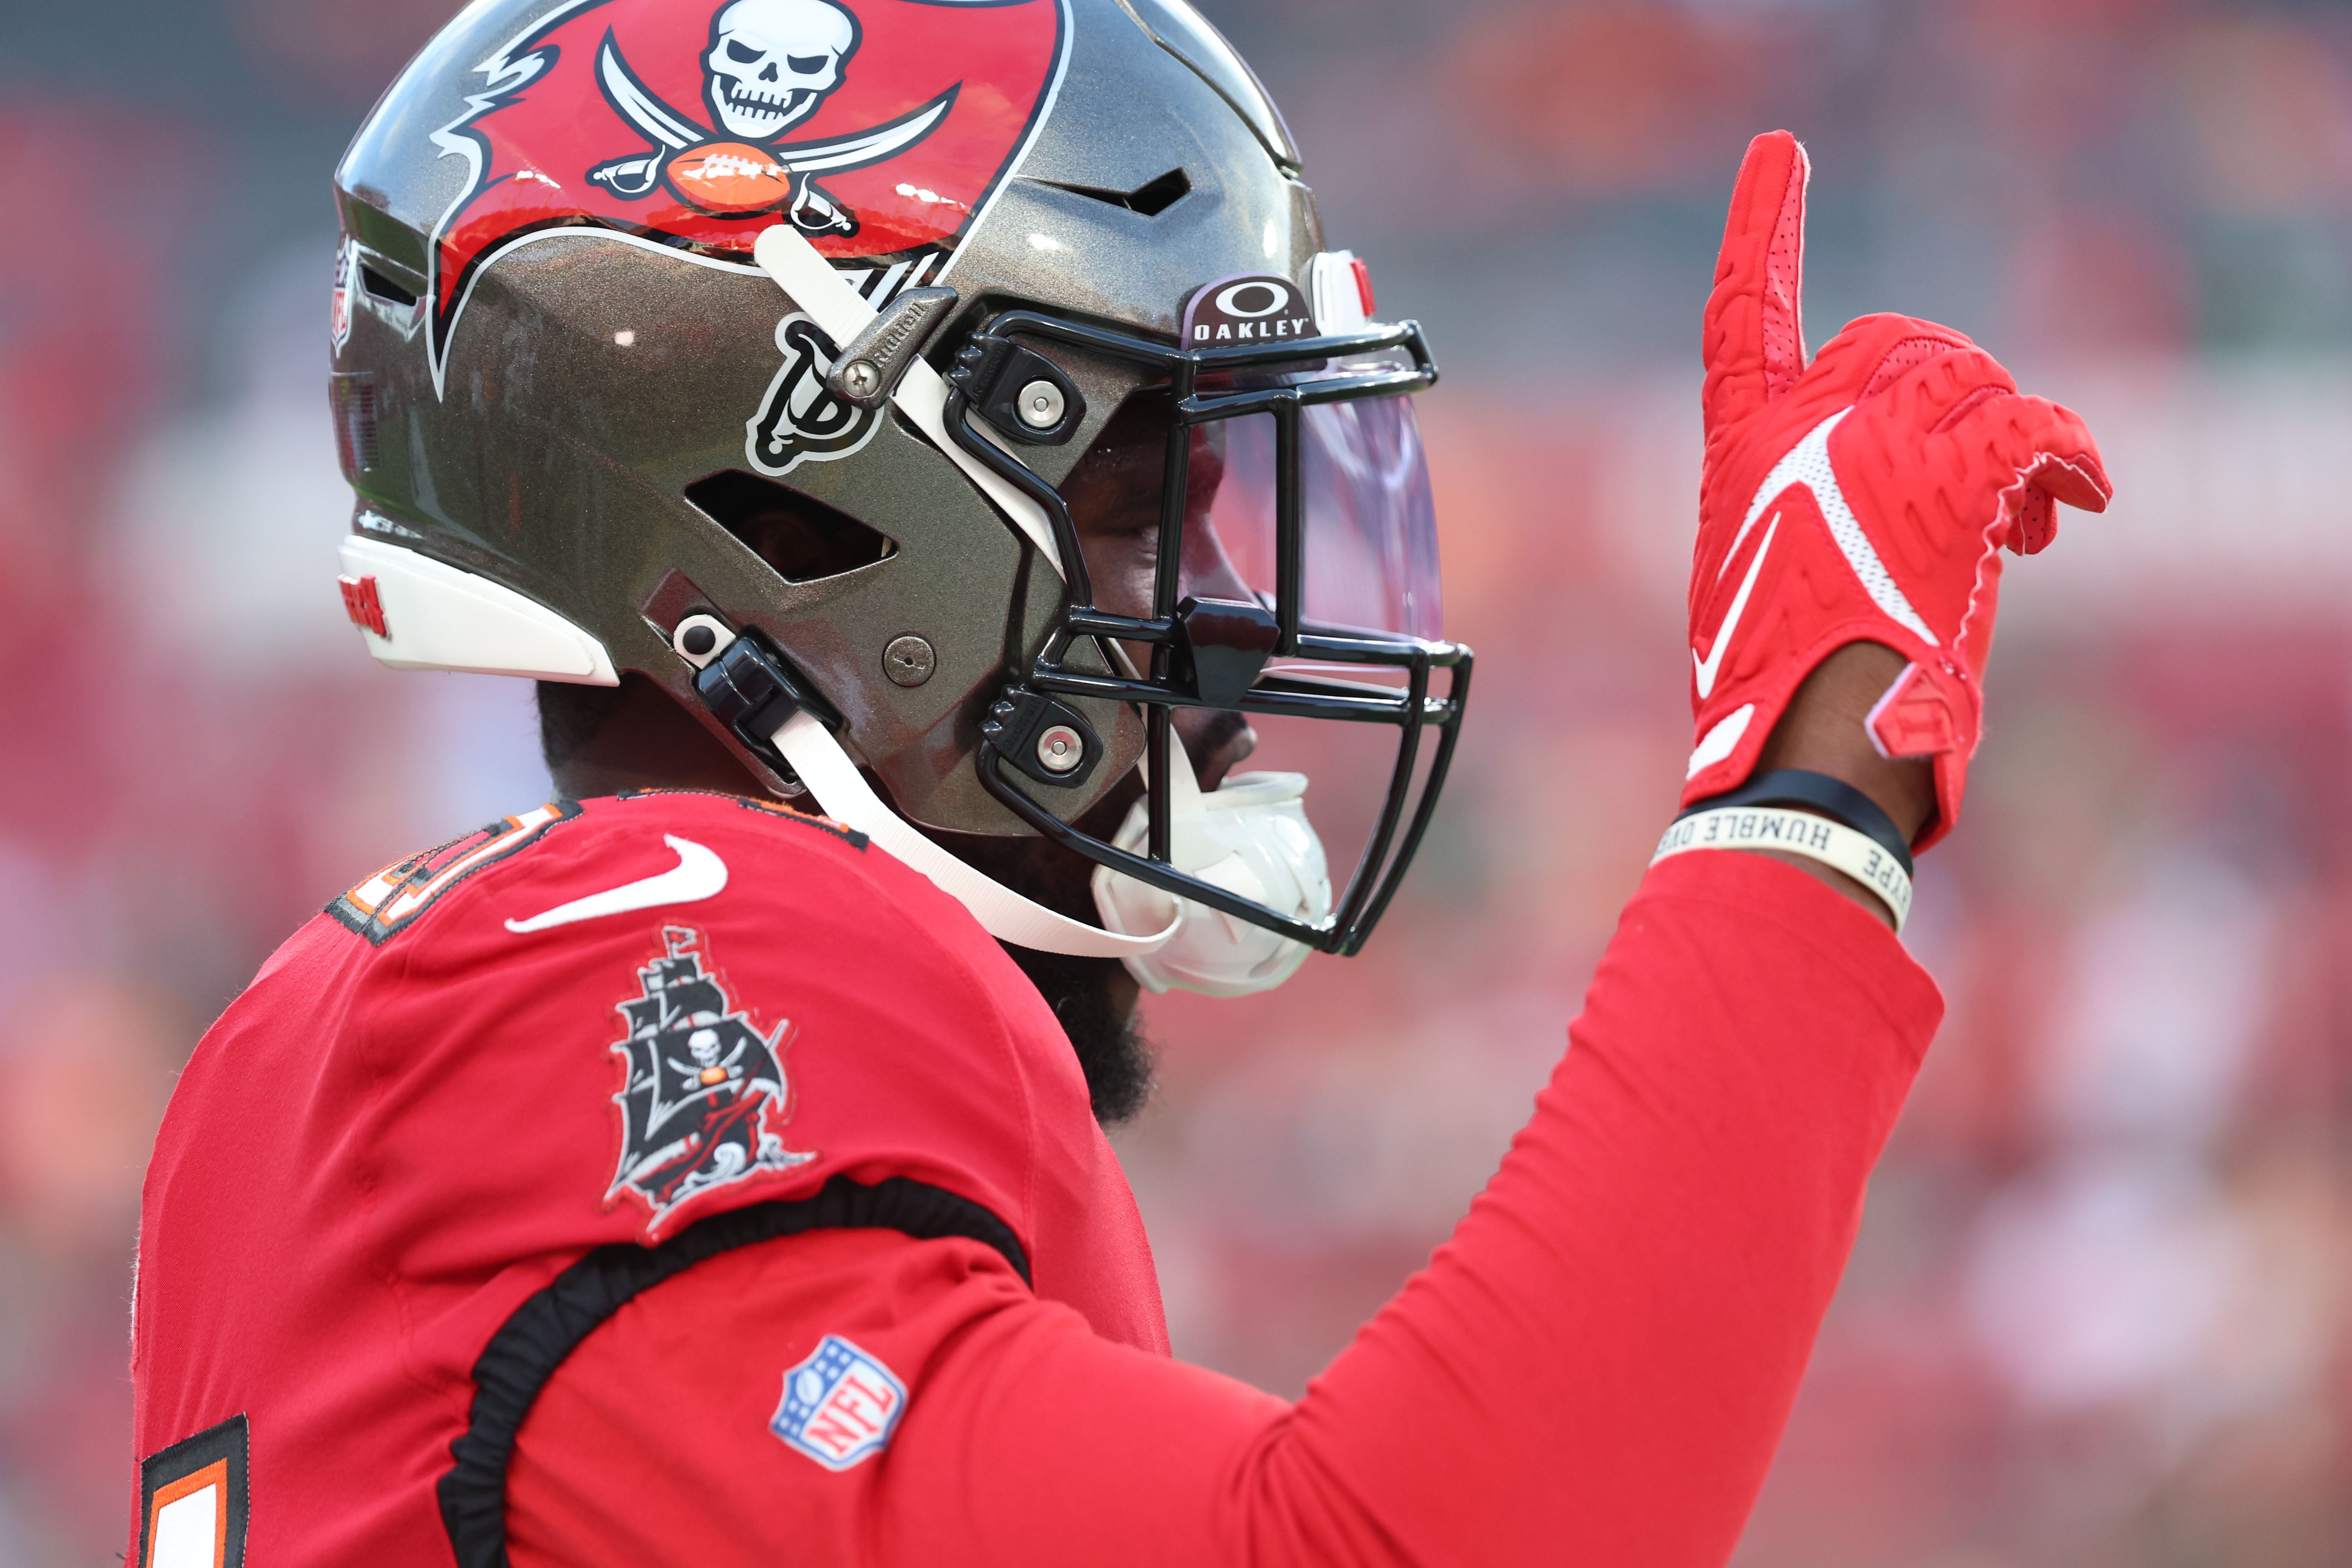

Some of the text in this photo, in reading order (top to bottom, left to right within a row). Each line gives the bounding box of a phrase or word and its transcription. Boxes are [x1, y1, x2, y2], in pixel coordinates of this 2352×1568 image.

[874, 302, 926, 368] Riddell
[1194, 318, 1304, 341] OAKLEY
[1704, 815, 1831, 850] HUMBLE
[805, 1373, 894, 1453] NFL
